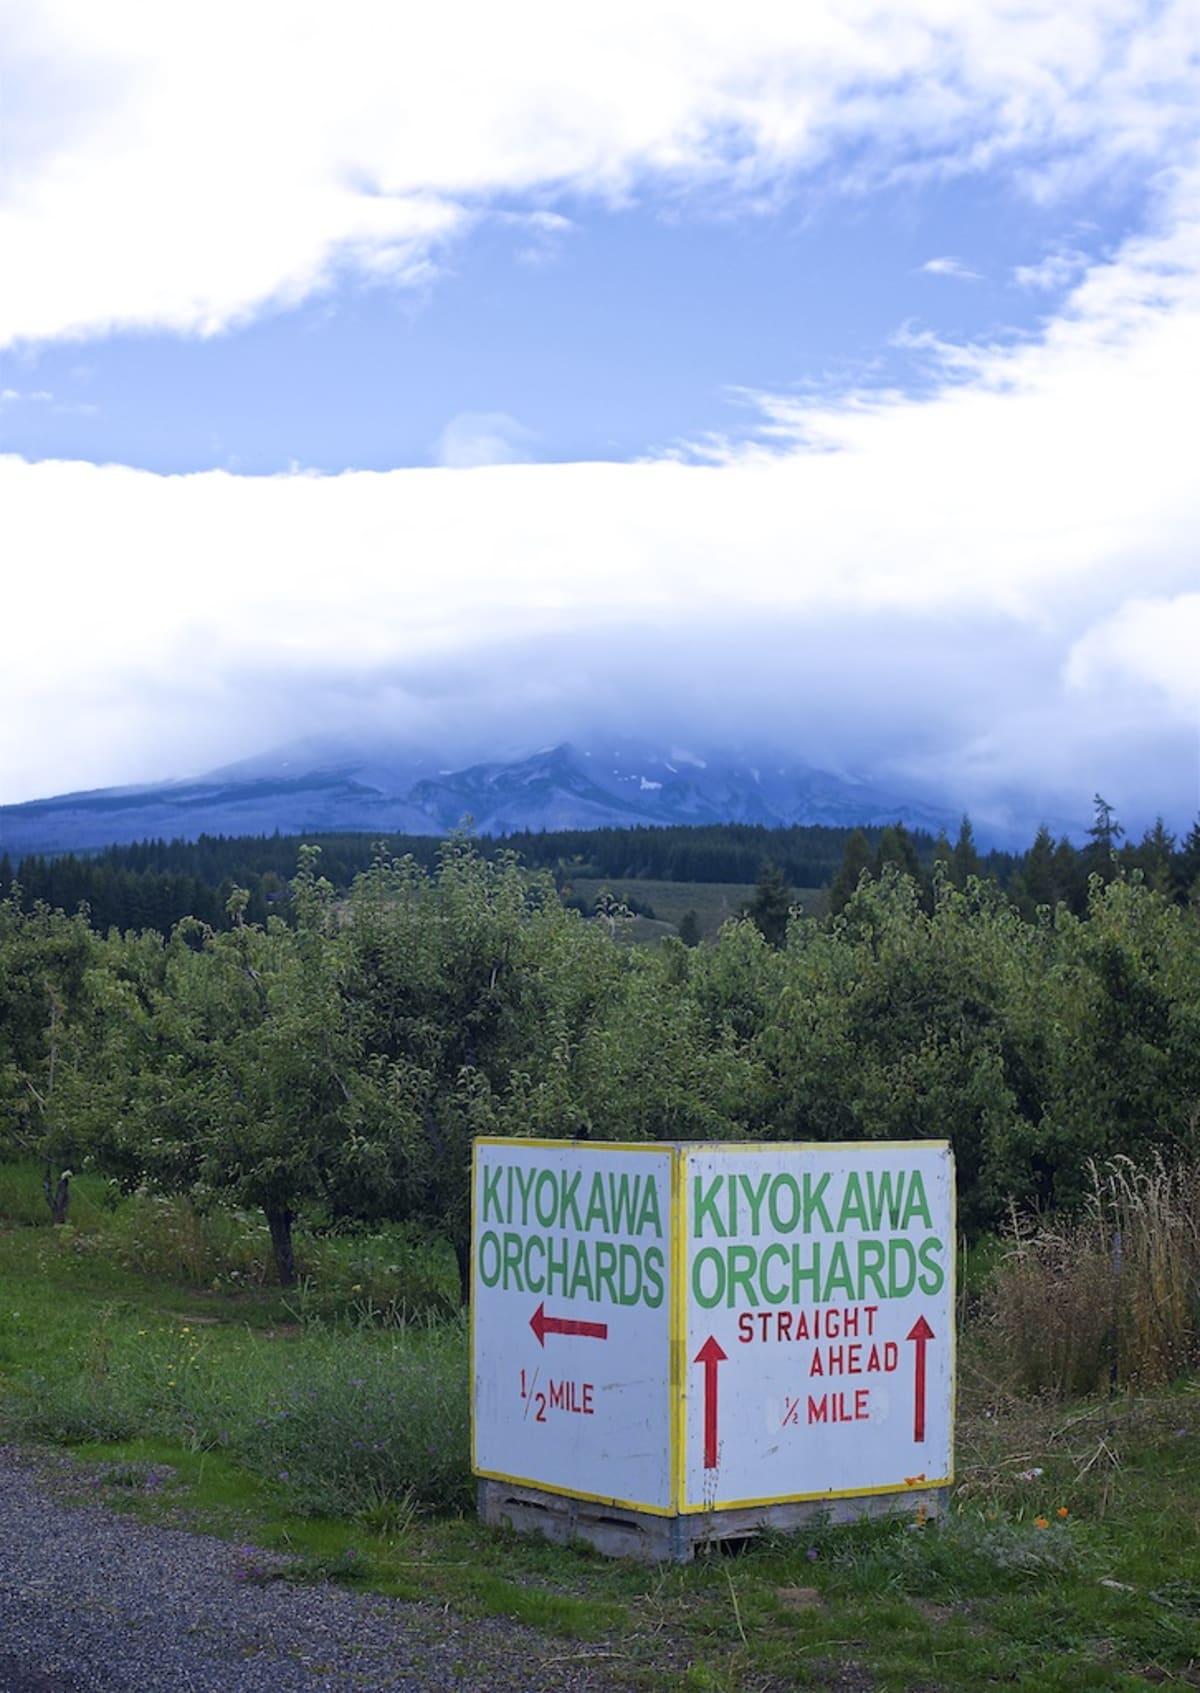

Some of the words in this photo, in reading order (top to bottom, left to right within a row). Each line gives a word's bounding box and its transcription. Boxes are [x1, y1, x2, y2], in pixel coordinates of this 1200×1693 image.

[482, 1165, 663, 1238] KIYOKAWA
[693, 1170, 933, 1238] KIYOKAWA
[479, 1231, 665, 1309] ORCHARDS
[691, 1237, 945, 1309] ORCHARDS
[738, 1306, 879, 1343] STRAIGHT
[809, 1341, 899, 1377] AHEAD
[549, 1378, 595, 1415] MILE
[807, 1389, 870, 1424] MILE
